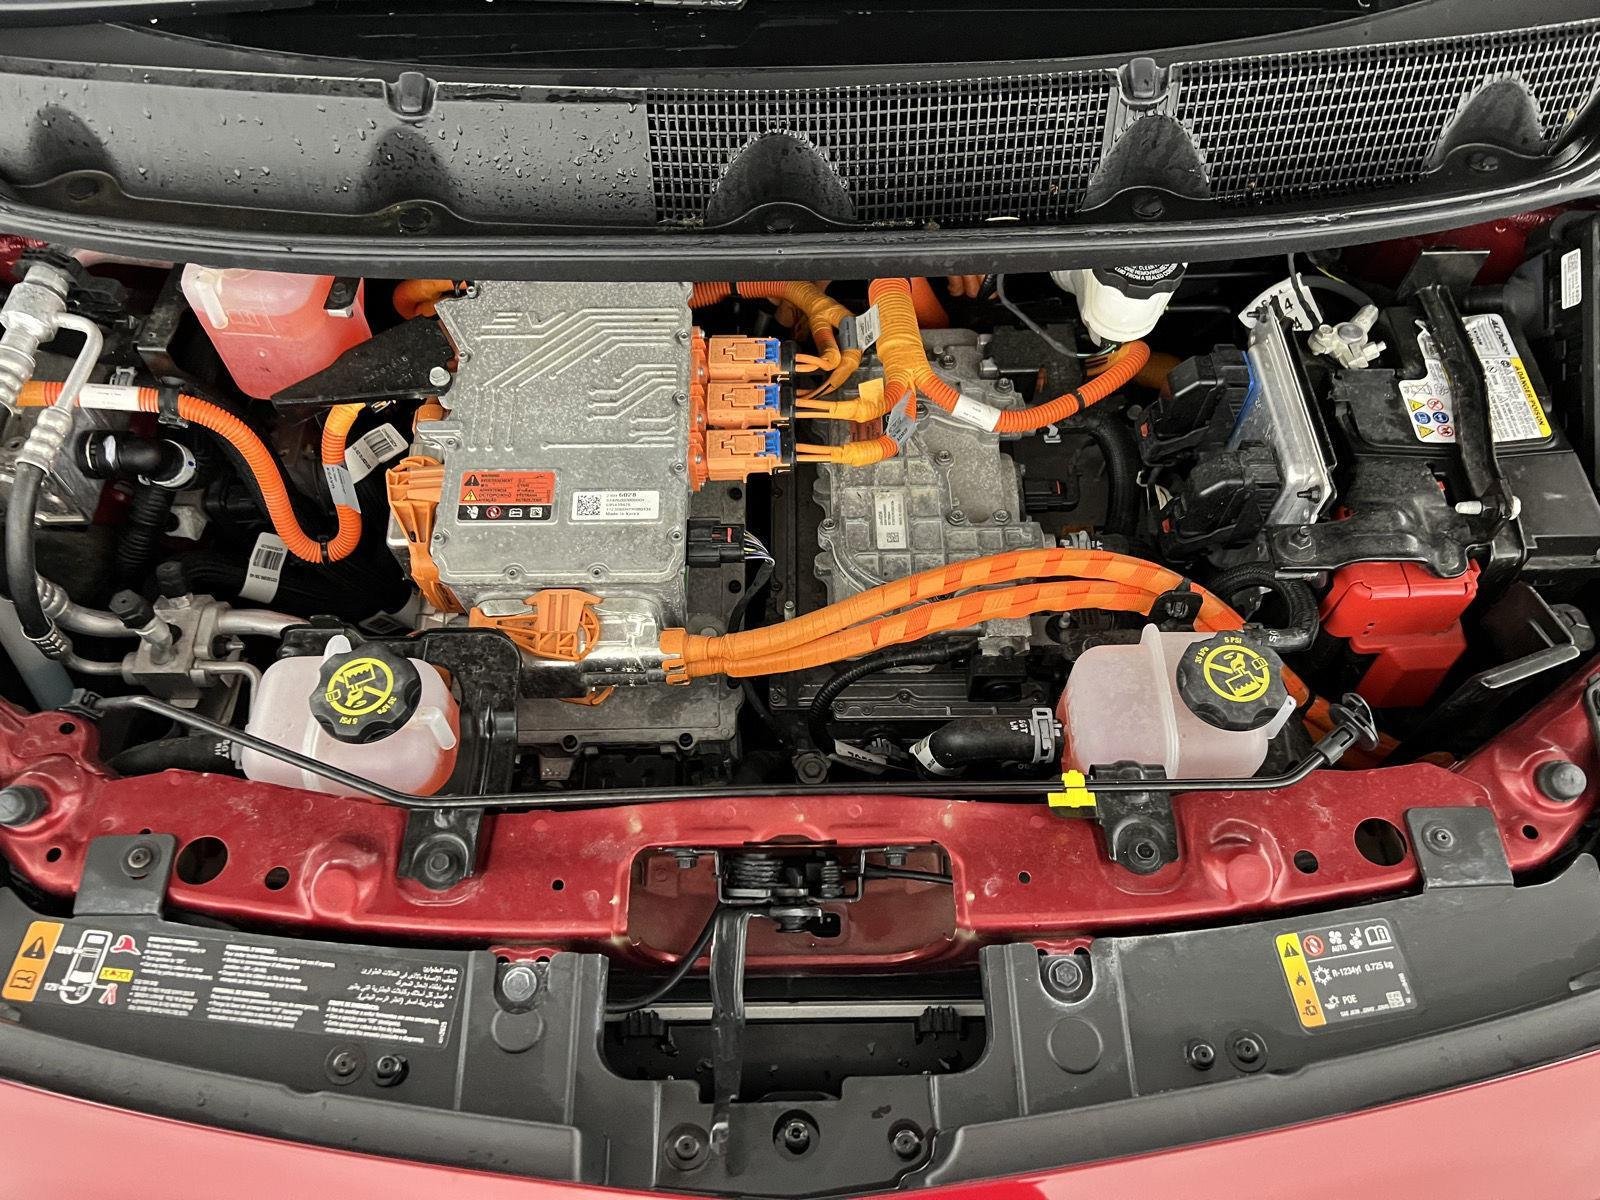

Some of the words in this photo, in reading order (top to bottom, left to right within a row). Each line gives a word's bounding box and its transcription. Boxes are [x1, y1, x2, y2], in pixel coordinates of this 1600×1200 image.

[1518, 369, 1533, 398] DANGER
[1530, 400, 1545, 426] POISON
[339, 716, 353, 725] PSI
[1331, 944, 1347, 953] AUTO
[1332, 966, 1362, 978] R-1234yf
[1365, 962, 1383, 972] 0.725
[1383, 960, 1394, 970] kg
[1342, 994, 1358, 1005] POE
